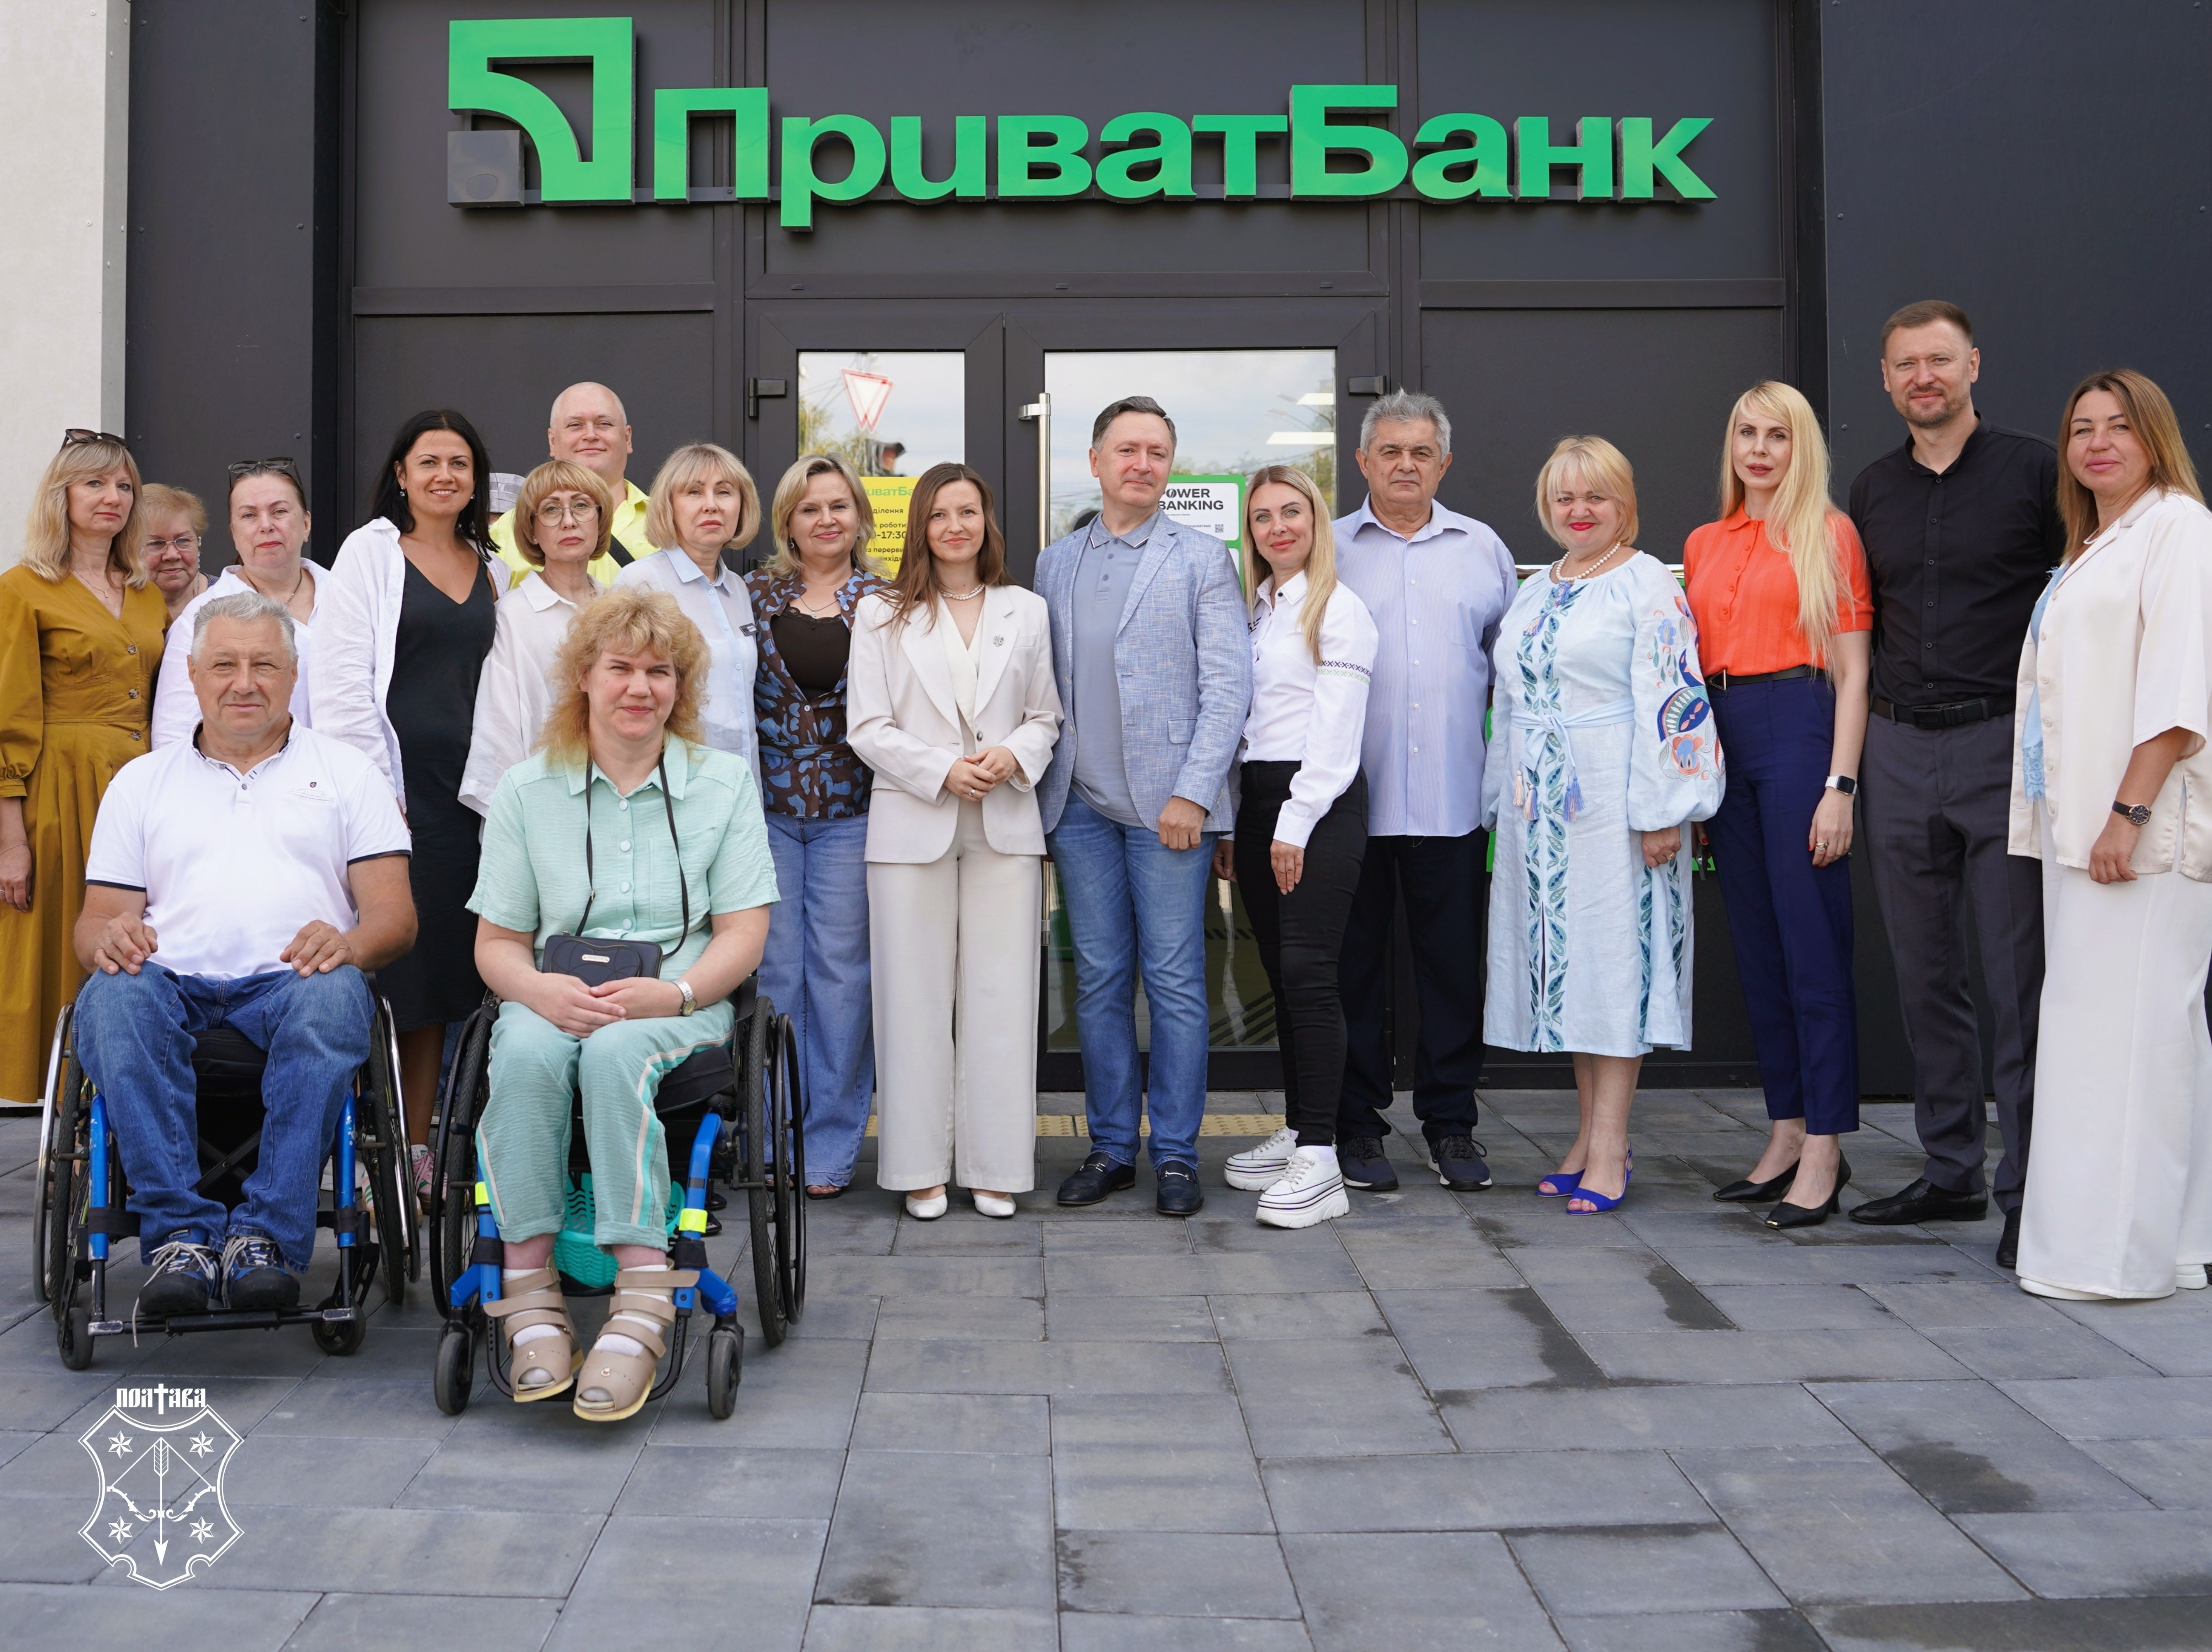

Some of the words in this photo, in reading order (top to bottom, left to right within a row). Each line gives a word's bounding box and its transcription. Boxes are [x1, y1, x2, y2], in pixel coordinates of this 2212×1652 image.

[654, 84, 1718, 231] ПриватБанк
[866, 487, 913, 496] иватБа
[1164, 489, 1210, 498] OWER
[1158, 501, 1224, 510] BANKING
